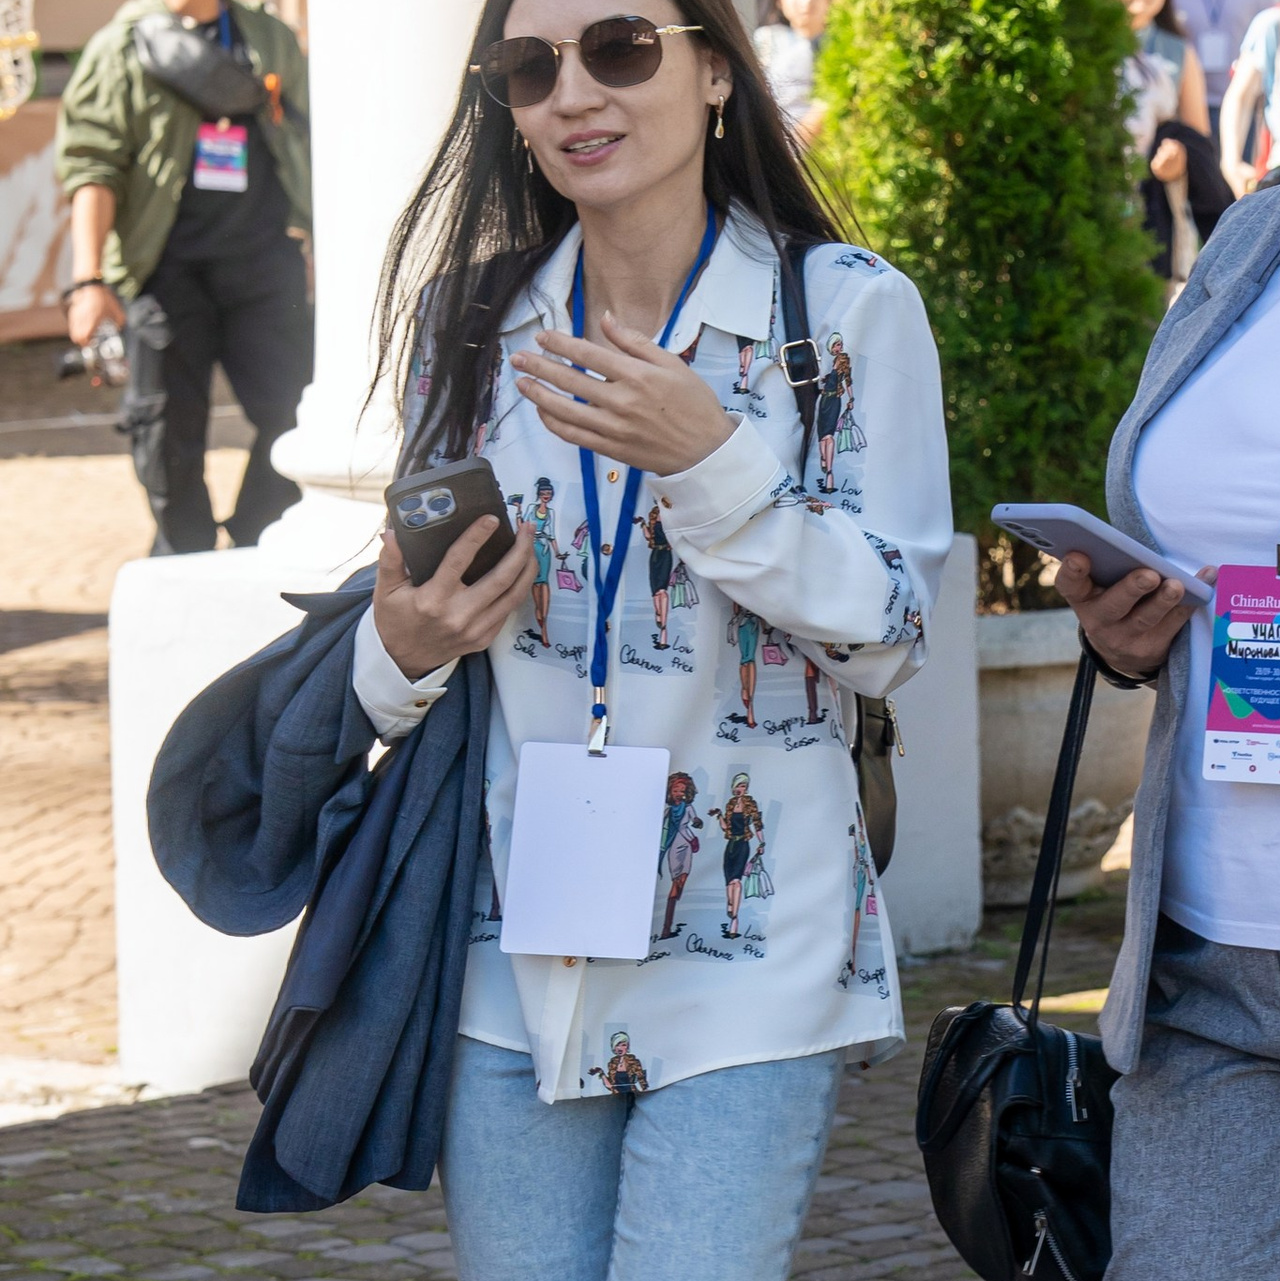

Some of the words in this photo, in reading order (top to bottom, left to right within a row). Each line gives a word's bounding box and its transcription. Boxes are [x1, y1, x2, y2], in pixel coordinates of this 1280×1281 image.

[841, 479, 863, 496] Low
[841, 499, 863, 514] Price
[672, 635, 695, 655] Low
[670, 656, 694, 673] Price
[743, 924, 767, 942] Low
[742, 943, 766, 959] Price
